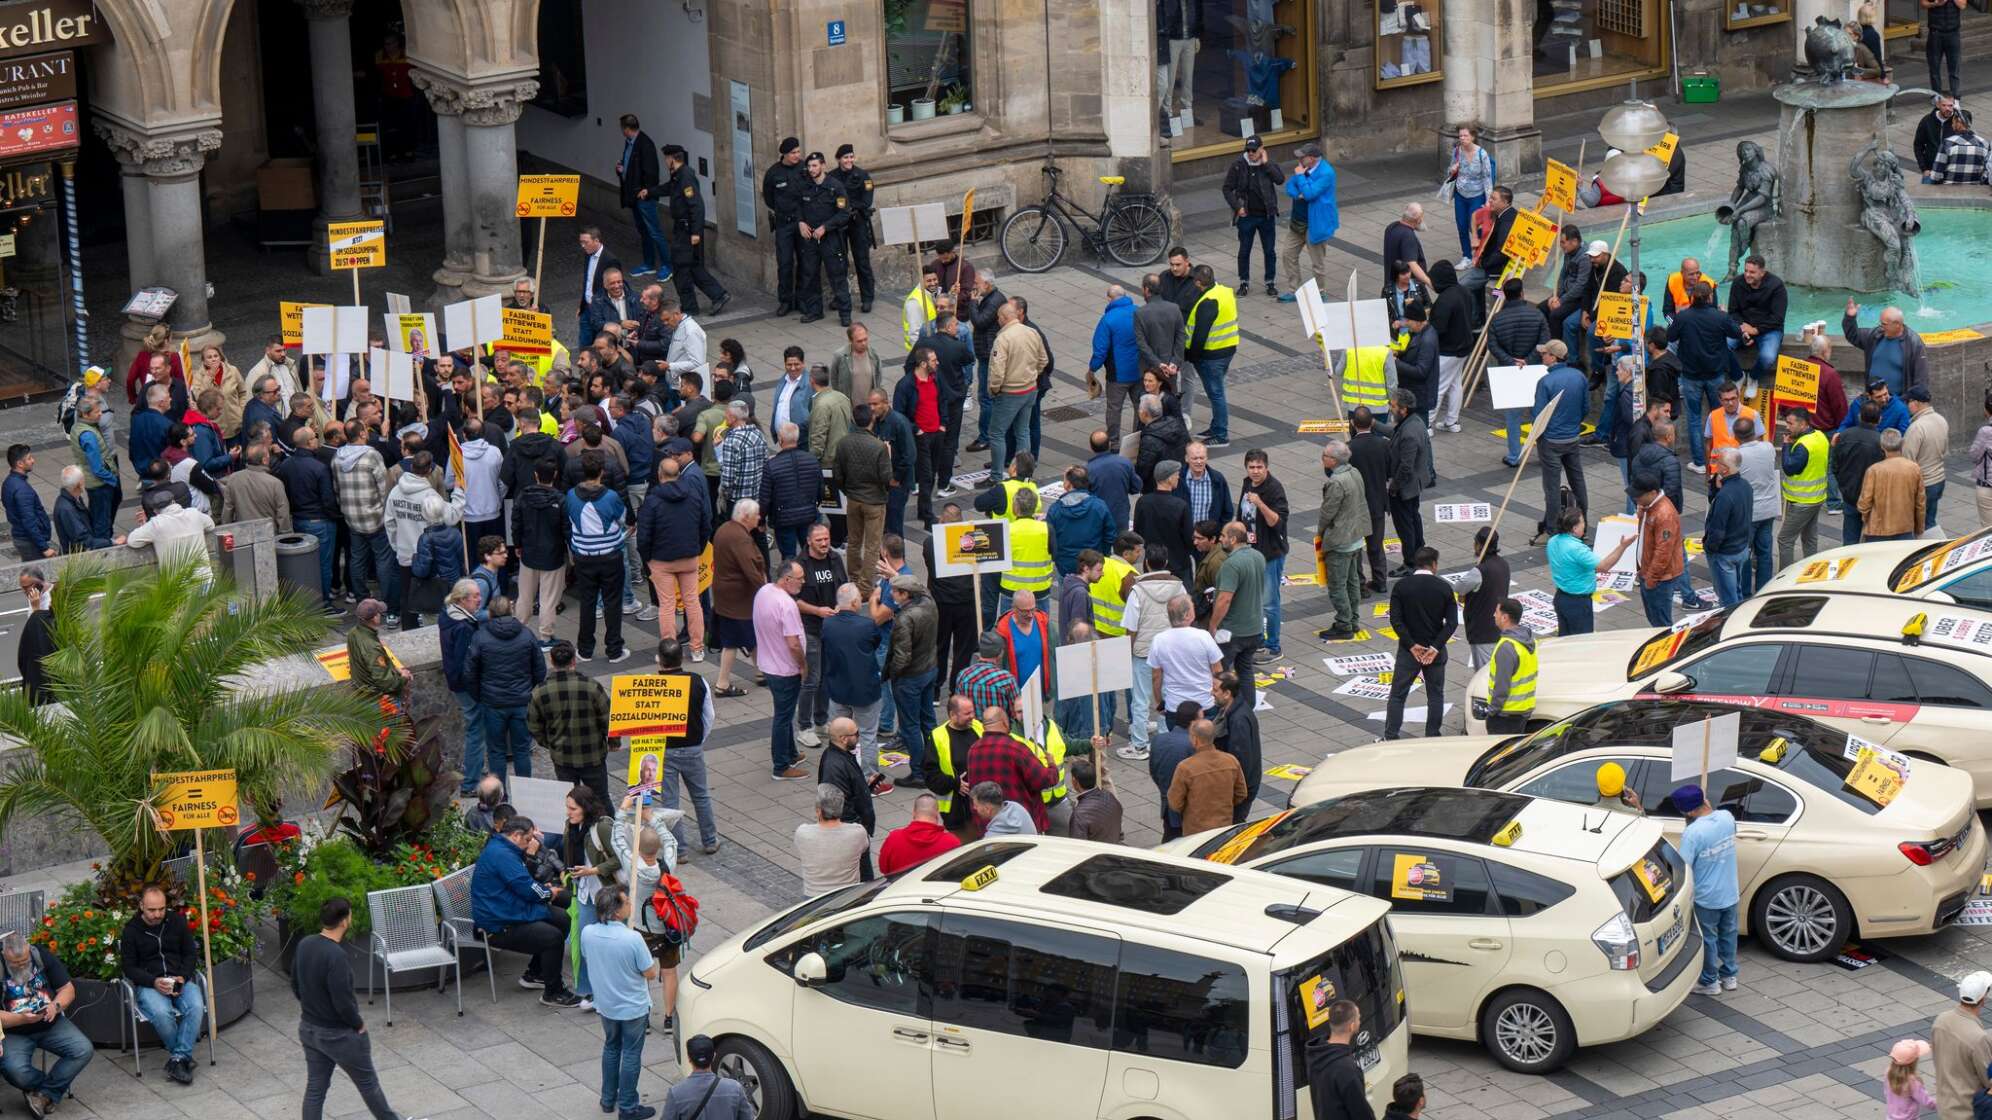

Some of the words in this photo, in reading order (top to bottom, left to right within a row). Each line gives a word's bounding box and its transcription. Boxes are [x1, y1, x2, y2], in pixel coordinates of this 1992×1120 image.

[833, 23, 841, 35] 8
[18, 84, 30, 92] Pub
[4, 107, 58, 121] RATSKELLER
[509, 311, 536, 321] FAIRER
[503, 317, 547, 329] ETTBEWERB
[1791, 361, 1809, 371] FAIRER
[1782, 367, 1816, 381] WETTBEWERB
[1791, 379, 1805, 387] STATT
[1776, 384, 1817, 400] SOZIALDUMPING
[1932, 617, 1957, 636] UBER
[633, 679, 667, 687] FAIRER
[619, 688, 682, 697] WETTBEWERB
[635, 700, 661, 708] STATT
[611, 712, 687, 722] SOZIALDUMPING
[172, 801, 217, 812] FAIRNESS
[197, 812, 211, 820] ALLE
[975, 867, 997, 887] TAXI
